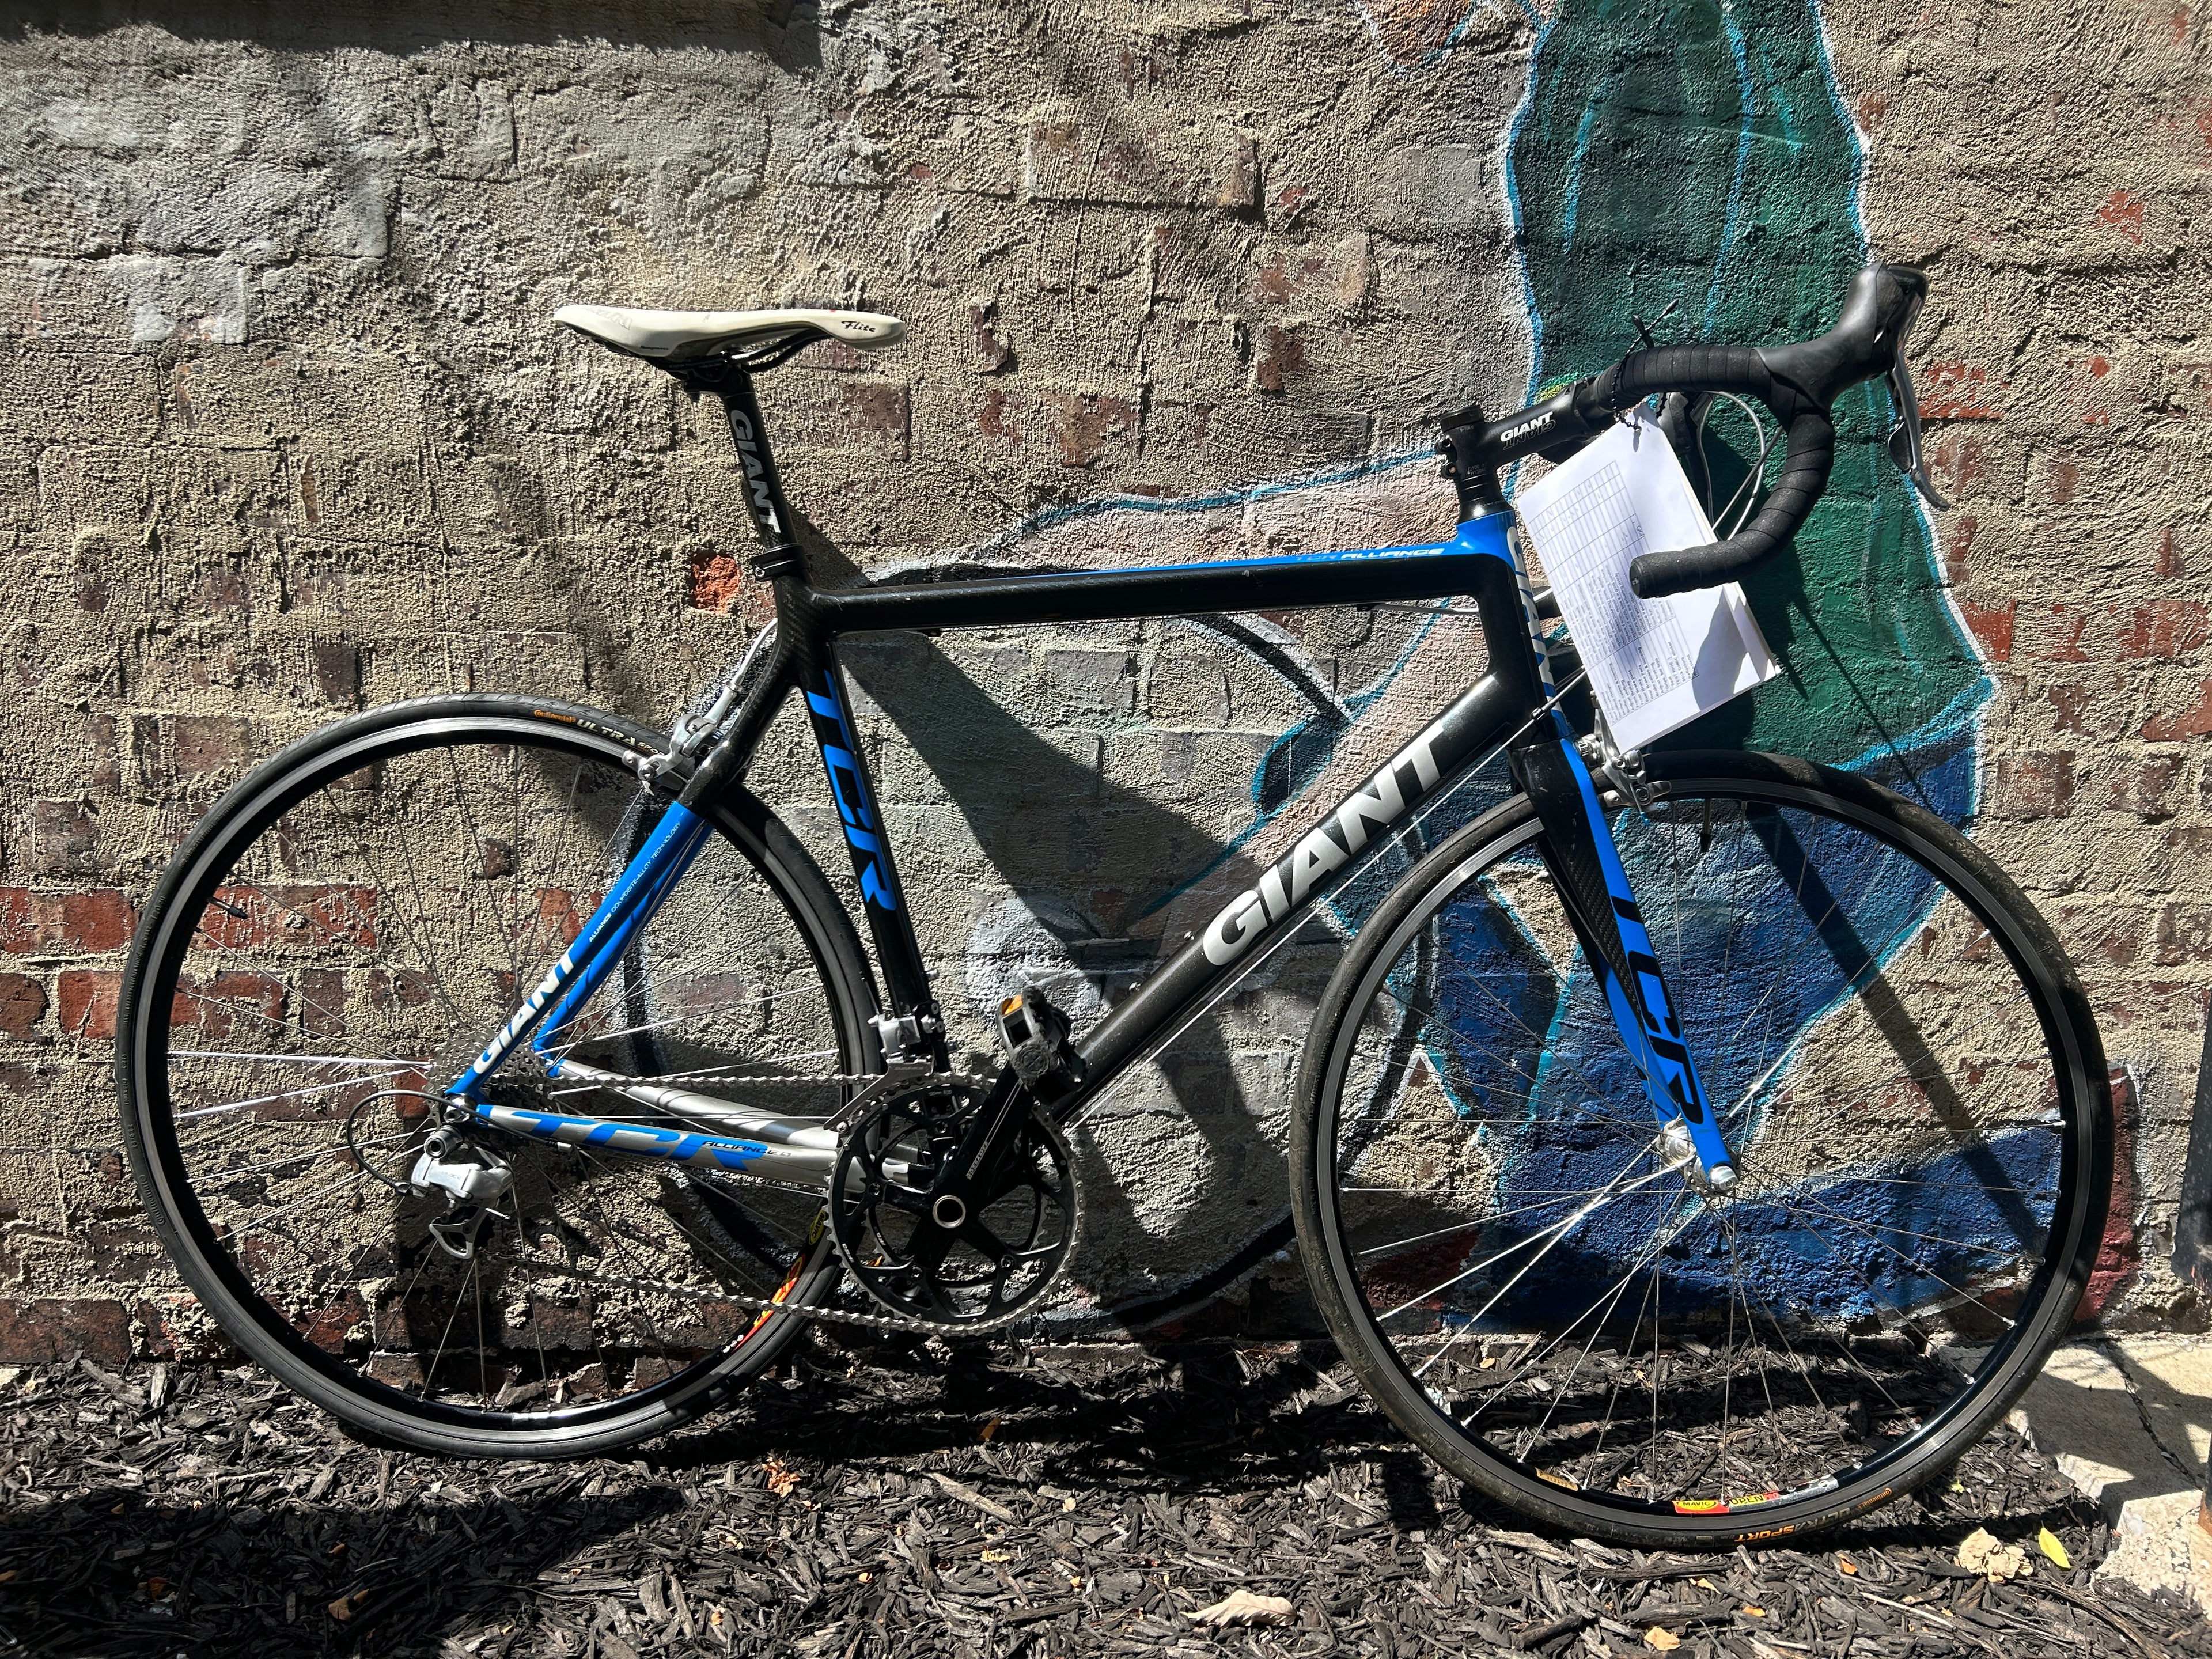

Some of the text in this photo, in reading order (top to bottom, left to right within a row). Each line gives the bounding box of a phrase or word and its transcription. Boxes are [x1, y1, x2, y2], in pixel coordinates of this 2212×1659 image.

[840, 320, 876, 334] Flite
[1500, 411, 1554, 442] GIANT
[730, 410, 781, 533] GIANT
[1340, 548, 1445, 559] ALLIANCE
[533, 709, 666, 756] Continental ULTRA SPO
[806, 670, 898, 911] TCR
[1203, 720, 1445, 967] GIANT
[586, 910, 613, 944] ALLIANCE
[650, 819, 683, 862] TECHNOLOGY
[472, 944, 577, 1075] GIANT
[510, 1111, 768, 1172] TCR
[702, 1140, 778, 1155] ALLIANCE
[811, 1211, 826, 1239] MAVIC
[1730, 1495, 1764, 1505] OPEN
[1734, 1488, 1892, 1543] Continental ULTRA SPORT
